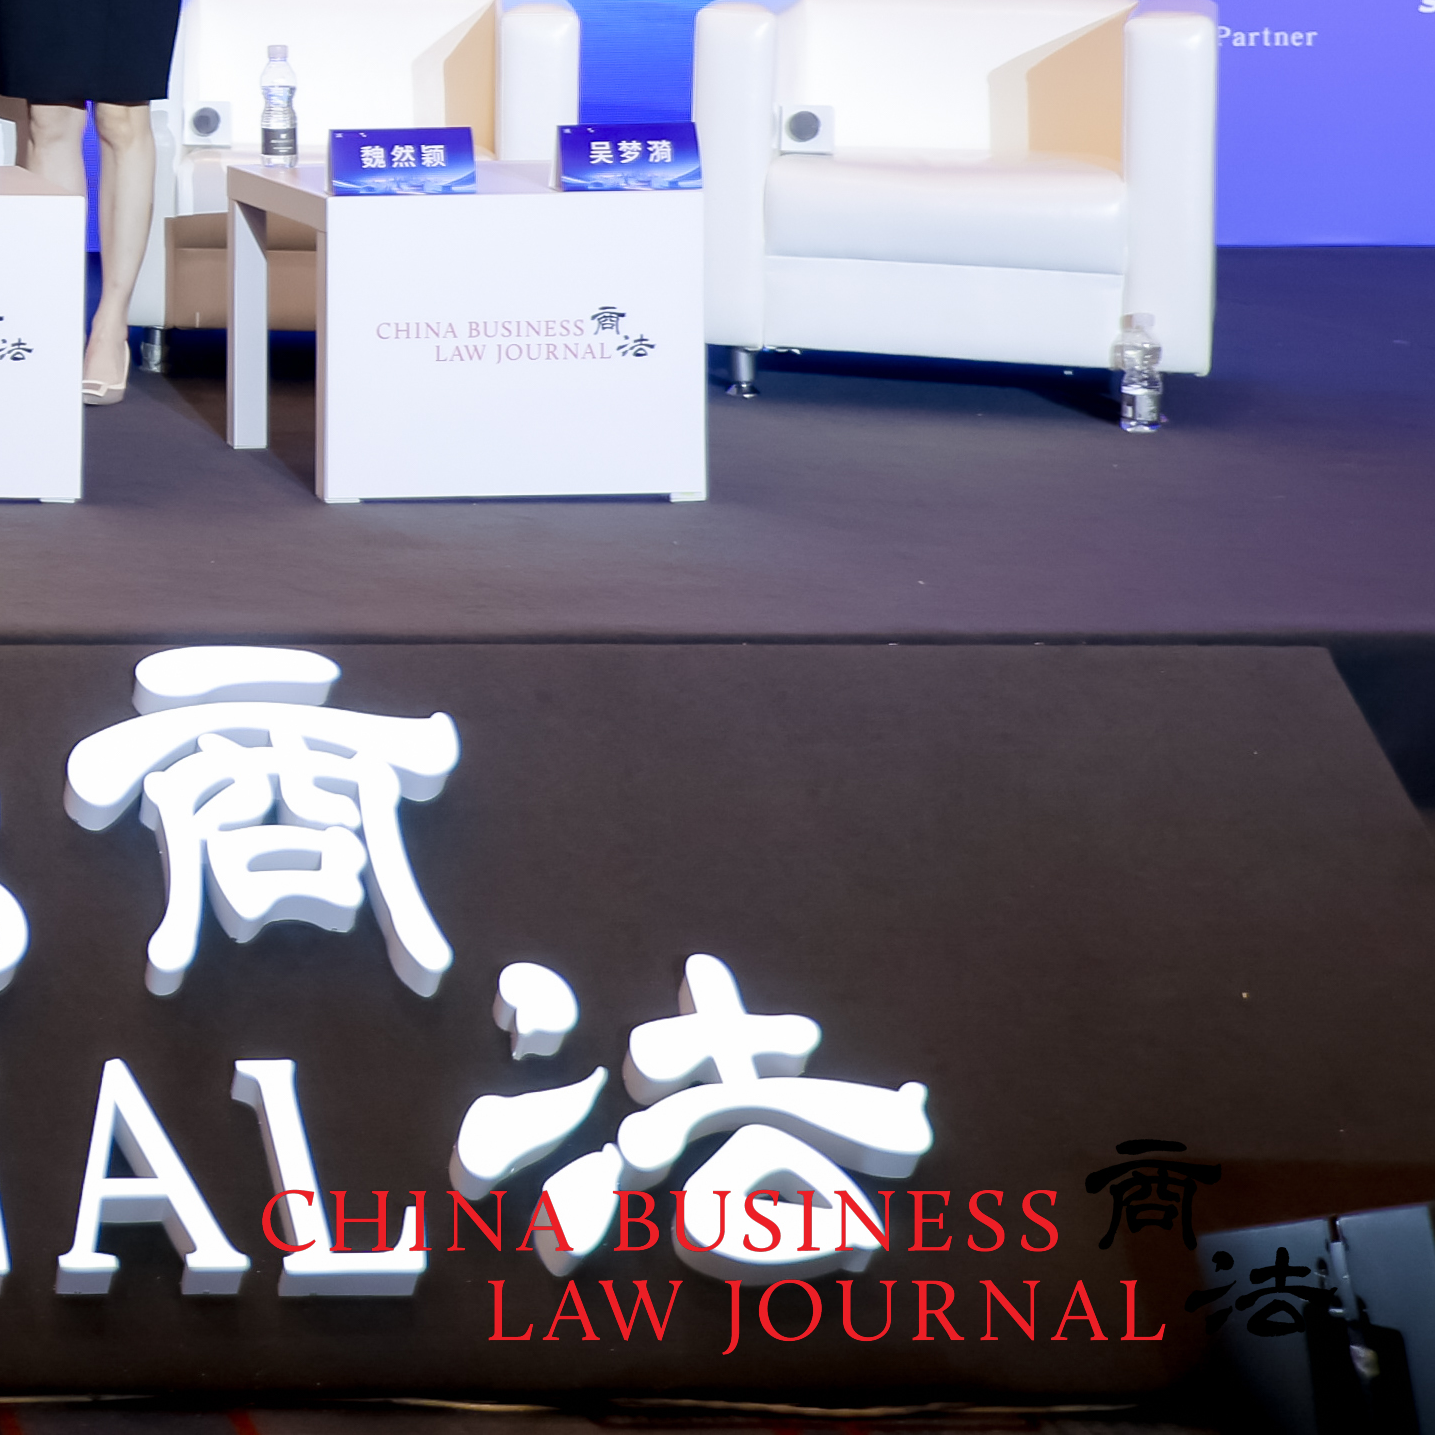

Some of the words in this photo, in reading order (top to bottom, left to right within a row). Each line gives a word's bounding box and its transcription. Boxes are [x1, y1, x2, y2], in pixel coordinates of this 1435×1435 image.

[1217, 25, 1318, 47] Partner
[360, 144, 446, 168] 魏然颖
[376, 322, 458, 340] CHINA
[468, 319, 585, 339] BUSINESS
[435, 344, 486, 362] LAW
[496, 342, 612, 364] JOURNAL
